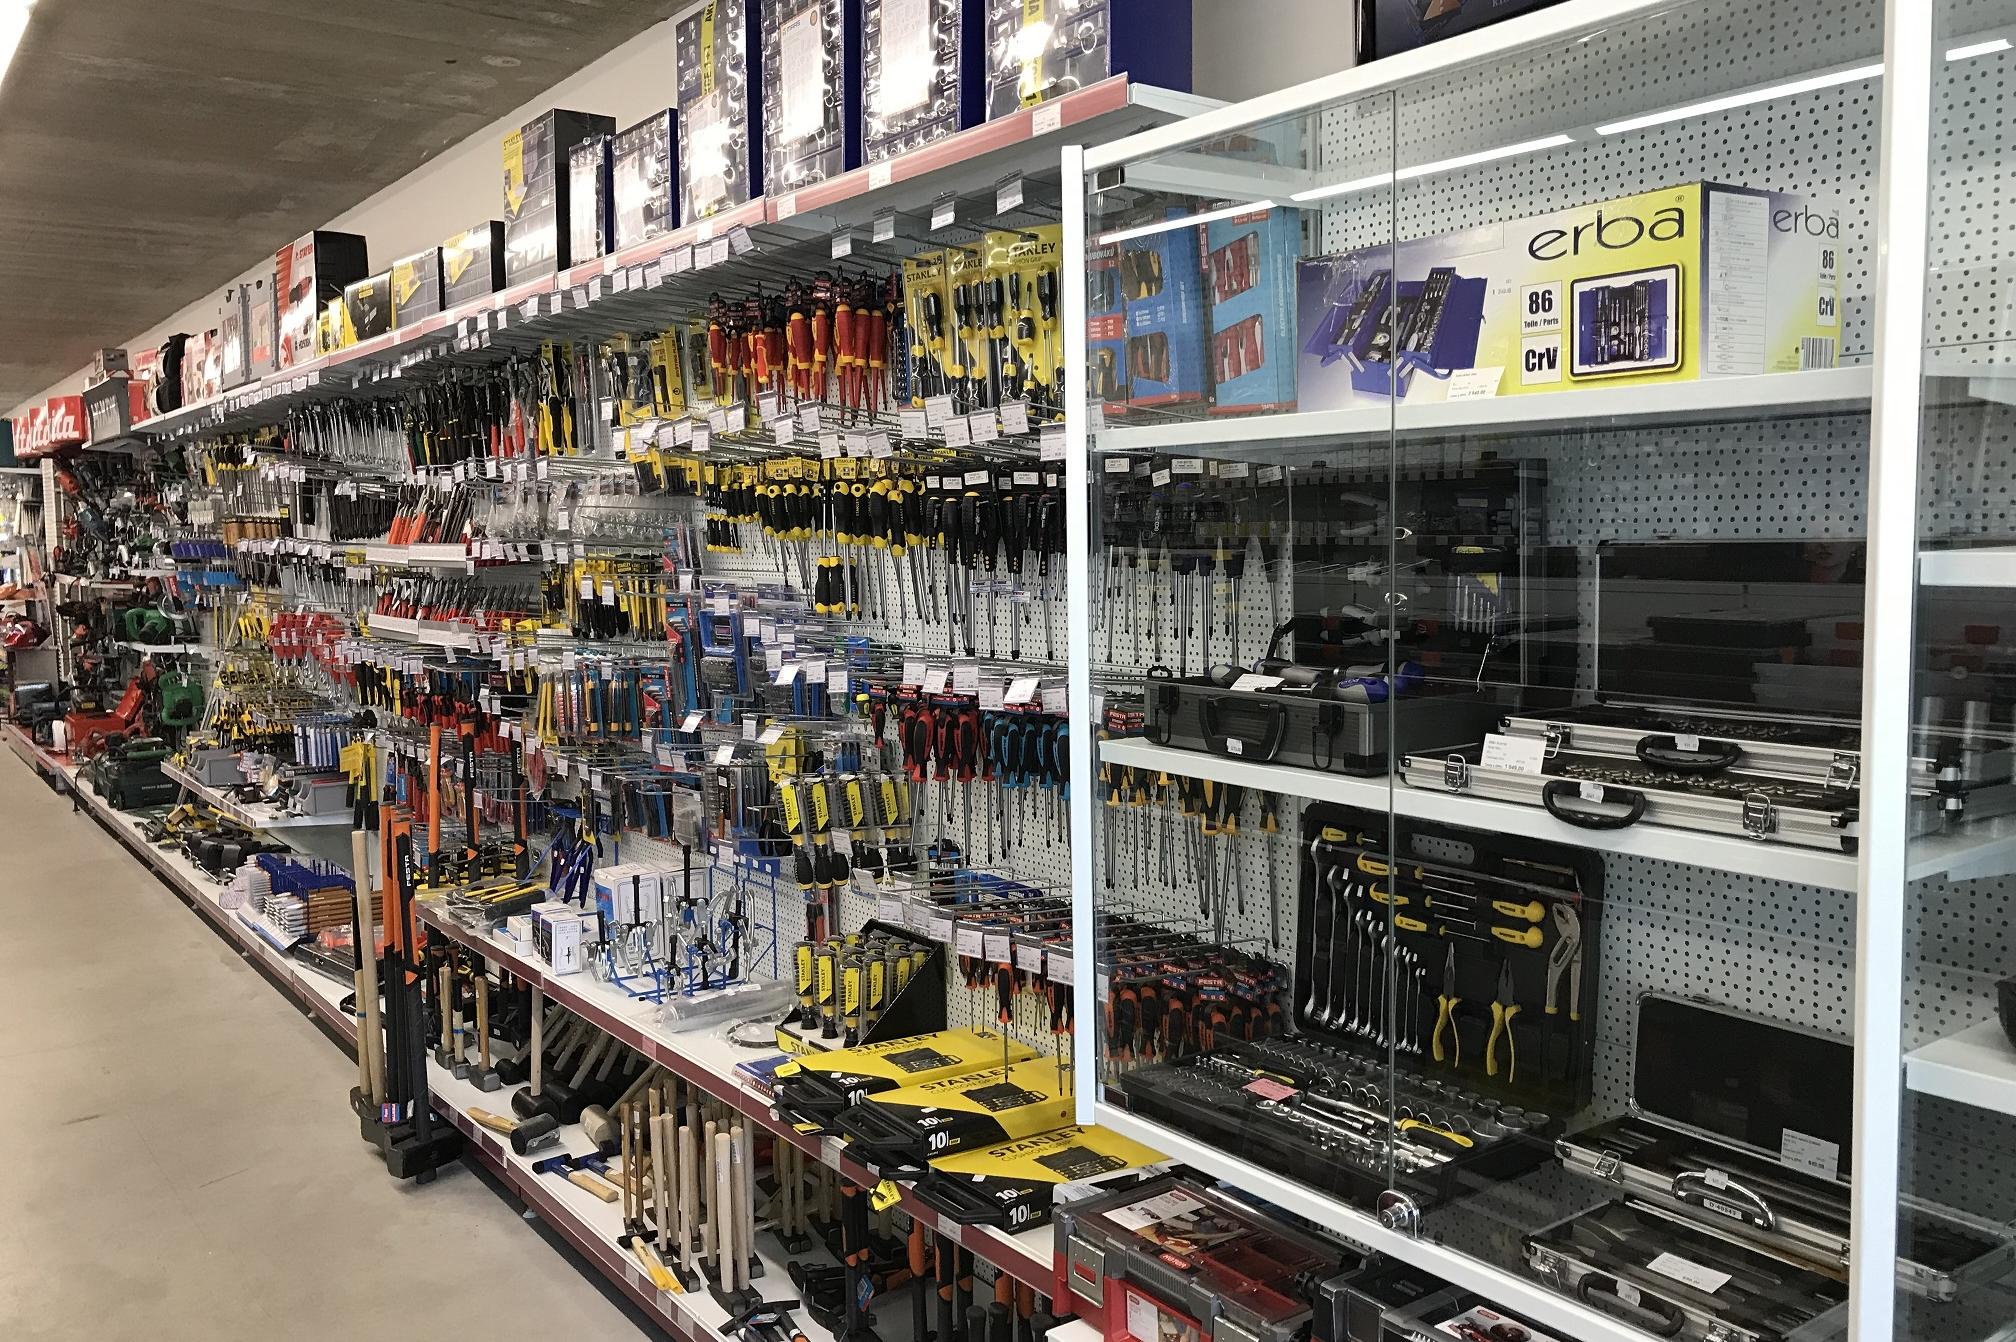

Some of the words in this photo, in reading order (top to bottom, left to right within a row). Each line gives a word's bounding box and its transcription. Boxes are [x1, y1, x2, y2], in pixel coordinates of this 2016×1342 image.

[1773, 204, 1840, 240] erba
[1528, 209, 1685, 260] erba
[1012, 242, 1056, 258] TANLEY
[1822, 250, 1835, 270] 86
[954, 257, 983, 269] STANLE
[1528, 289, 1553, 315] 86
[1818, 296, 1835, 317] CrV
[1543, 317, 1559, 326] Parts
[1524, 346, 1559, 373] CrV
[838, 1075, 857, 1085] 10
[920, 1066, 1016, 1091] STANLEY
[847, 1089, 866, 1107] 10
[917, 1117, 938, 1127] 10
[928, 1131, 947, 1151] 10
[988, 1126, 1086, 1158] STANLEY
[1001, 1145, 1048, 1162] CUSHION
[995, 1188, 1018, 1200] 10
[1008, 1205, 1027, 1226] 10
